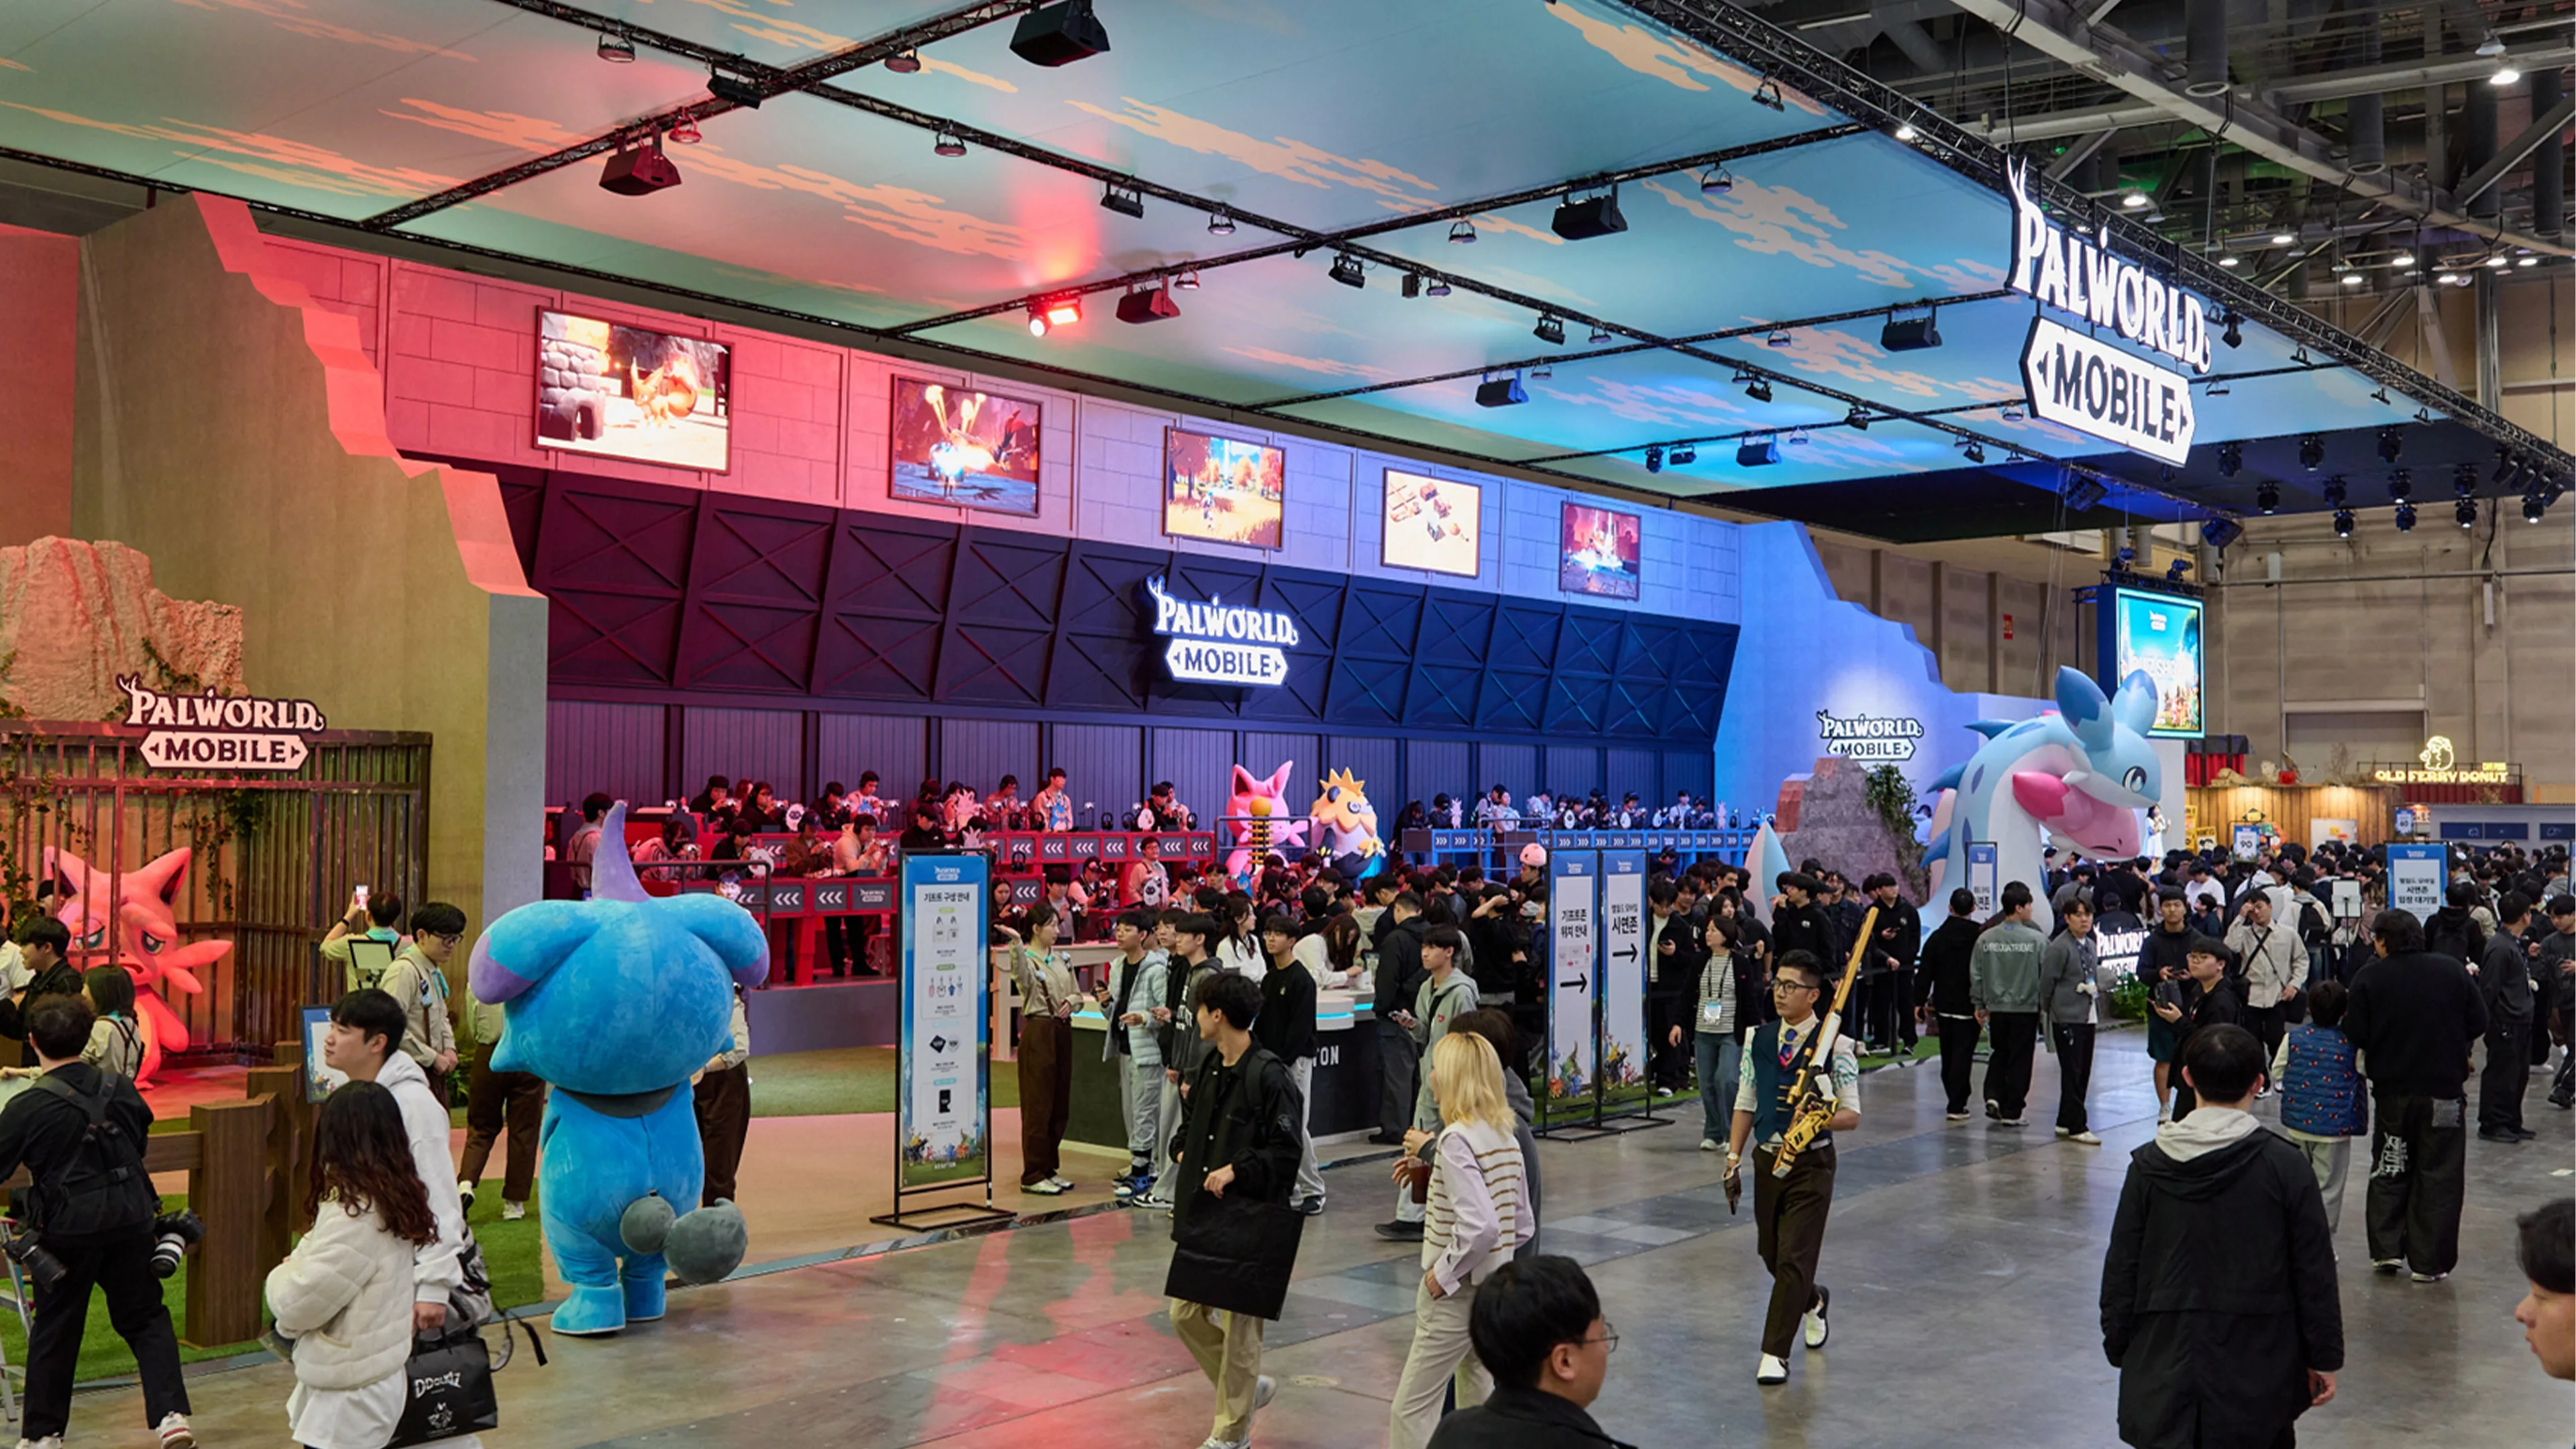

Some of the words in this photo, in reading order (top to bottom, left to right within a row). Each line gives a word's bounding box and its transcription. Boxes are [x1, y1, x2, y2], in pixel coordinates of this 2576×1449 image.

[2007, 154, 2211, 374] PALWORLD
[2053, 343, 2176, 444] MOBILE
[1147, 576, 1299, 646] PALWORLD
[1184, 647, 1272, 678] MOBILE
[117, 674, 325, 731] PALWORLD
[1817, 710, 1924, 738] PALWORLD
[164, 737, 287, 763] MOBILE
[1840, 742, 1902, 756] MOBILE
[2375, 770, 2406, 782] OLD
[2407, 771, 2458, 783] FERRY
[2459, 771, 2508, 783] DONUT
[2239, 840, 2253, 849] 90
[1612, 916, 1638, 935] 시연존
